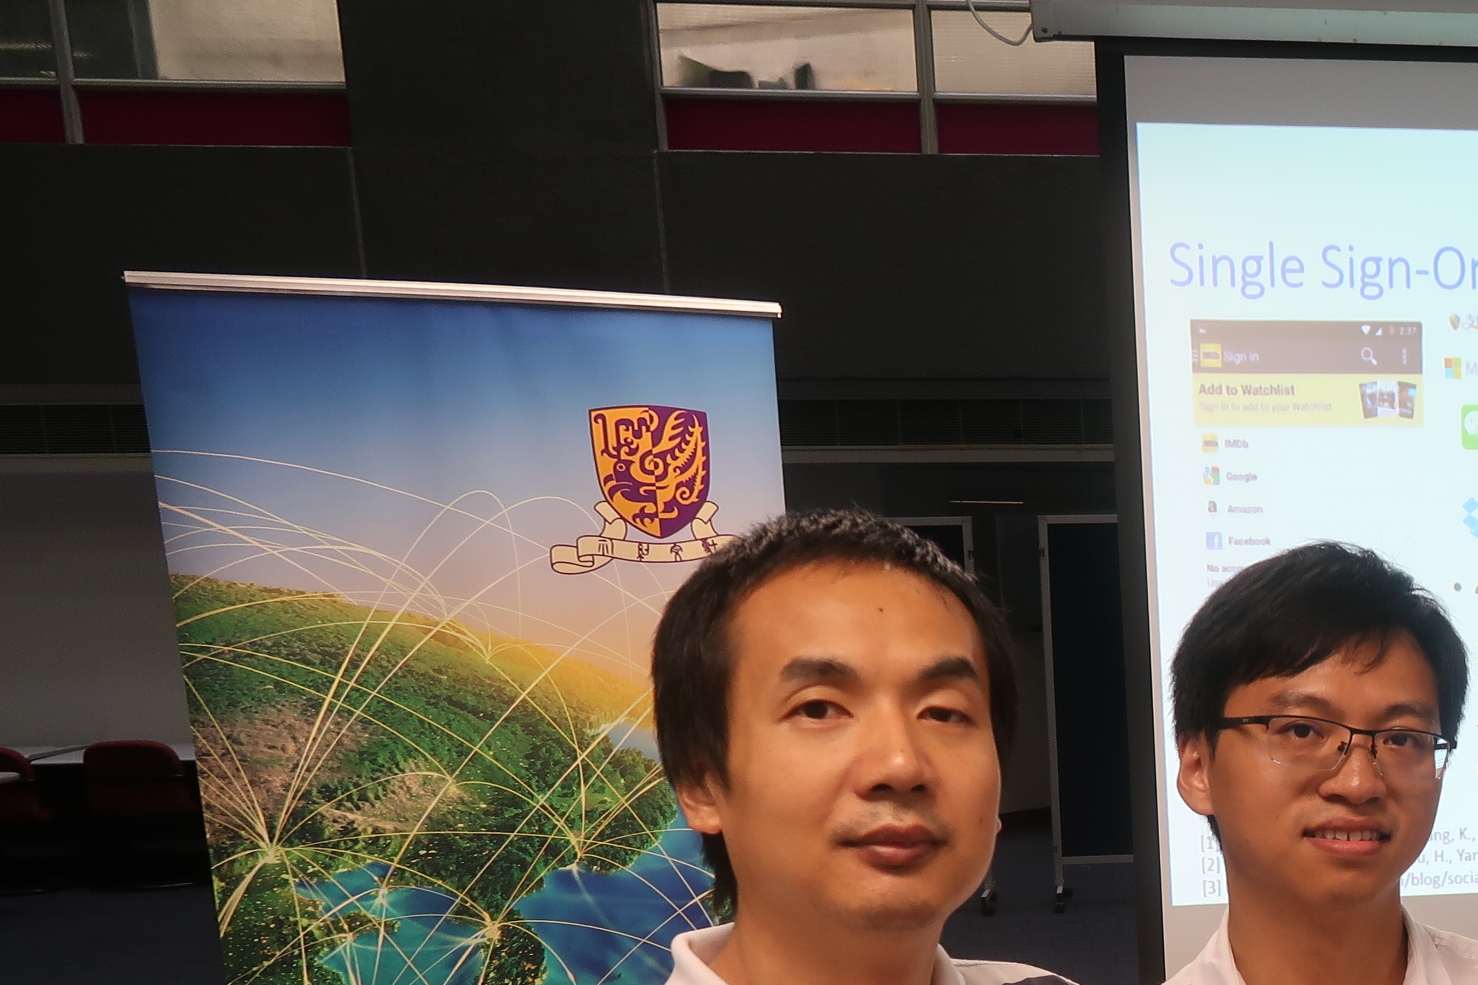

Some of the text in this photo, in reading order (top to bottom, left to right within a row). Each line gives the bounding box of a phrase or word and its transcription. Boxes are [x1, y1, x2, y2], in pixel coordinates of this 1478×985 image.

[1169, 241, 1305, 298] Single
[1224, 351, 1259, 365] Sign in
[1199, 383, 1296, 396] Add to Watchlist
[1242, 402, 1254, 412] add
[1256, 403, 1268, 411] to
[1226, 472, 1257, 483] Google
[1227, 505, 1263, 514] Amazon
[1228, 536, 1271, 546] Facebook
[1203, 856, 1221, 875] [2]
[1204, 880, 1221, 898] [3]
